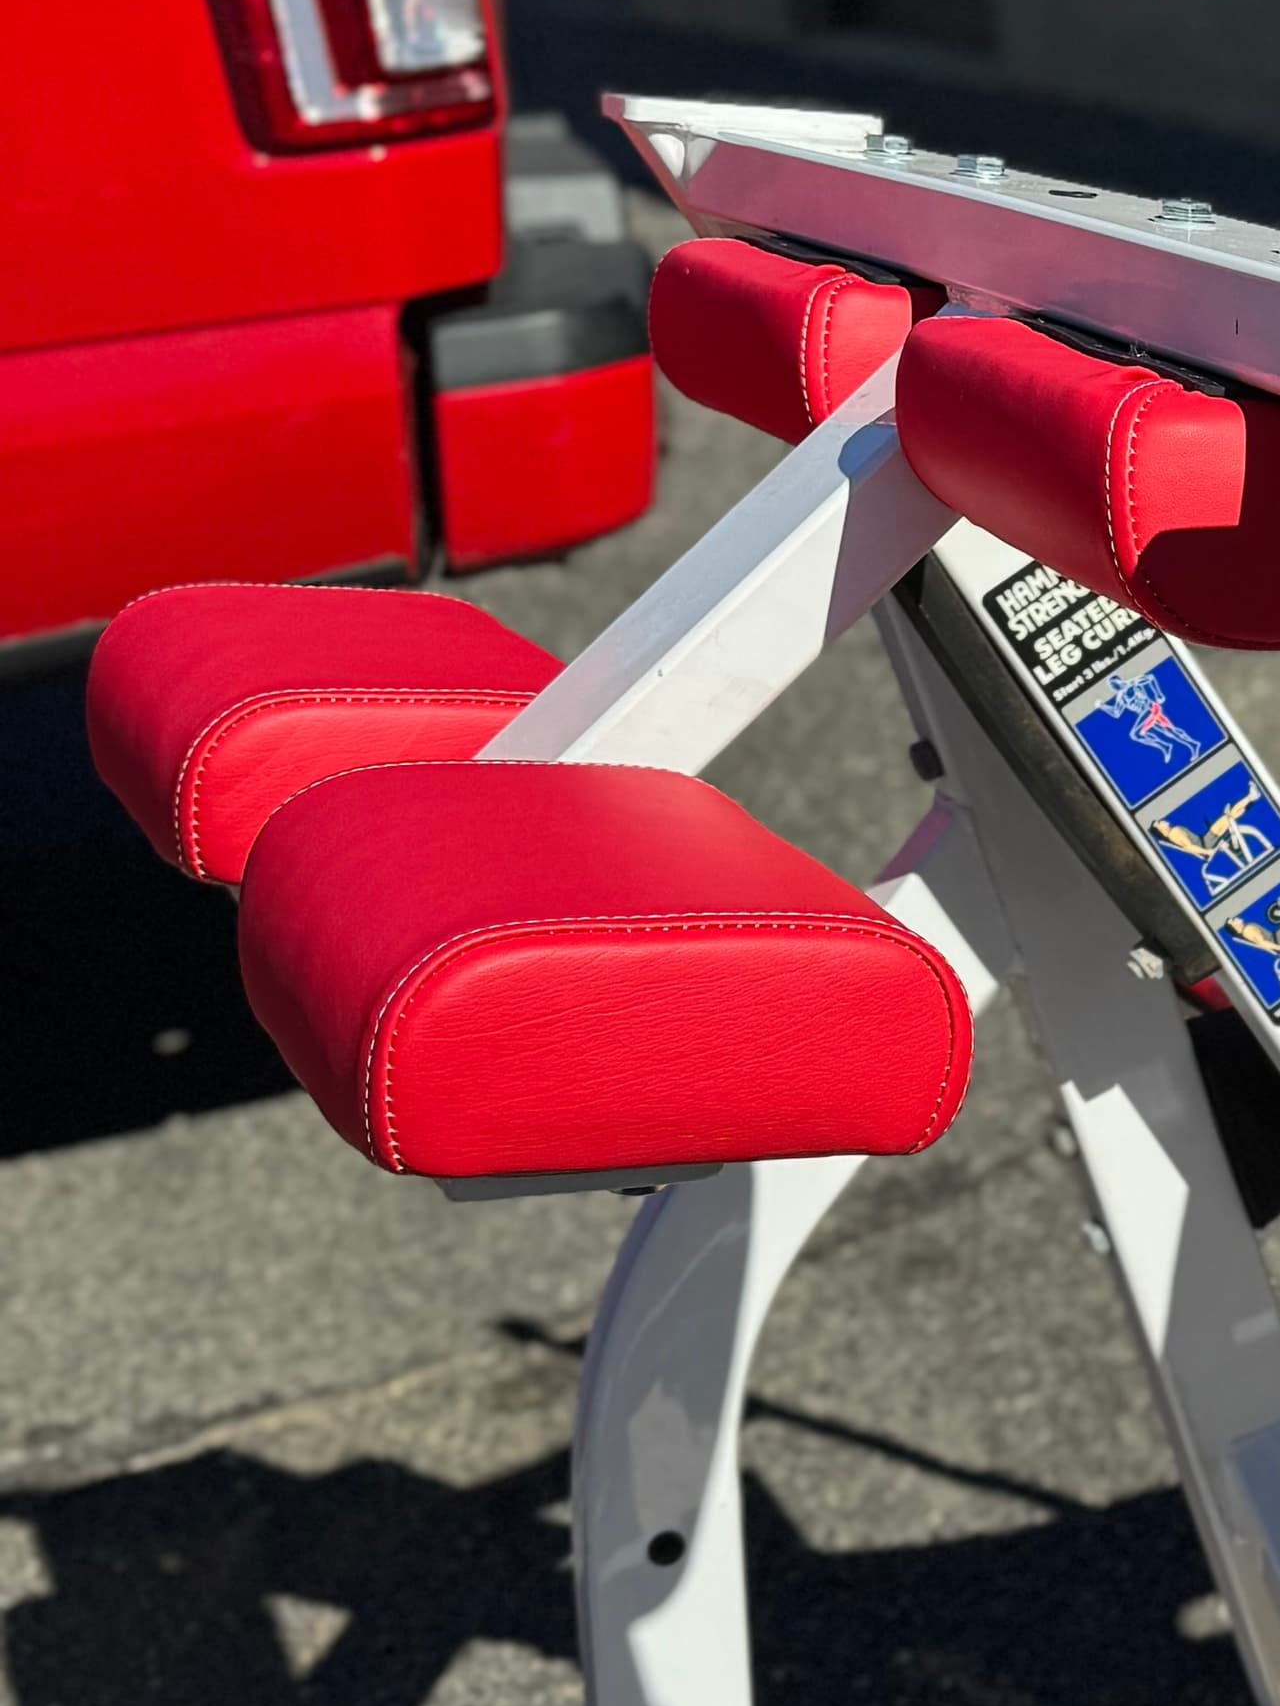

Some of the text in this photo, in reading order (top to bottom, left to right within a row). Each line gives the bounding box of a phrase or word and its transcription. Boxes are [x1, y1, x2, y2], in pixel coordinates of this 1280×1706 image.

[995, 565, 1061, 618] HAM
[1007, 579, 1090, 641] STRENG
[1033, 644, 1082, 686] LEG
[1083, 667, 1094, 680] 3
